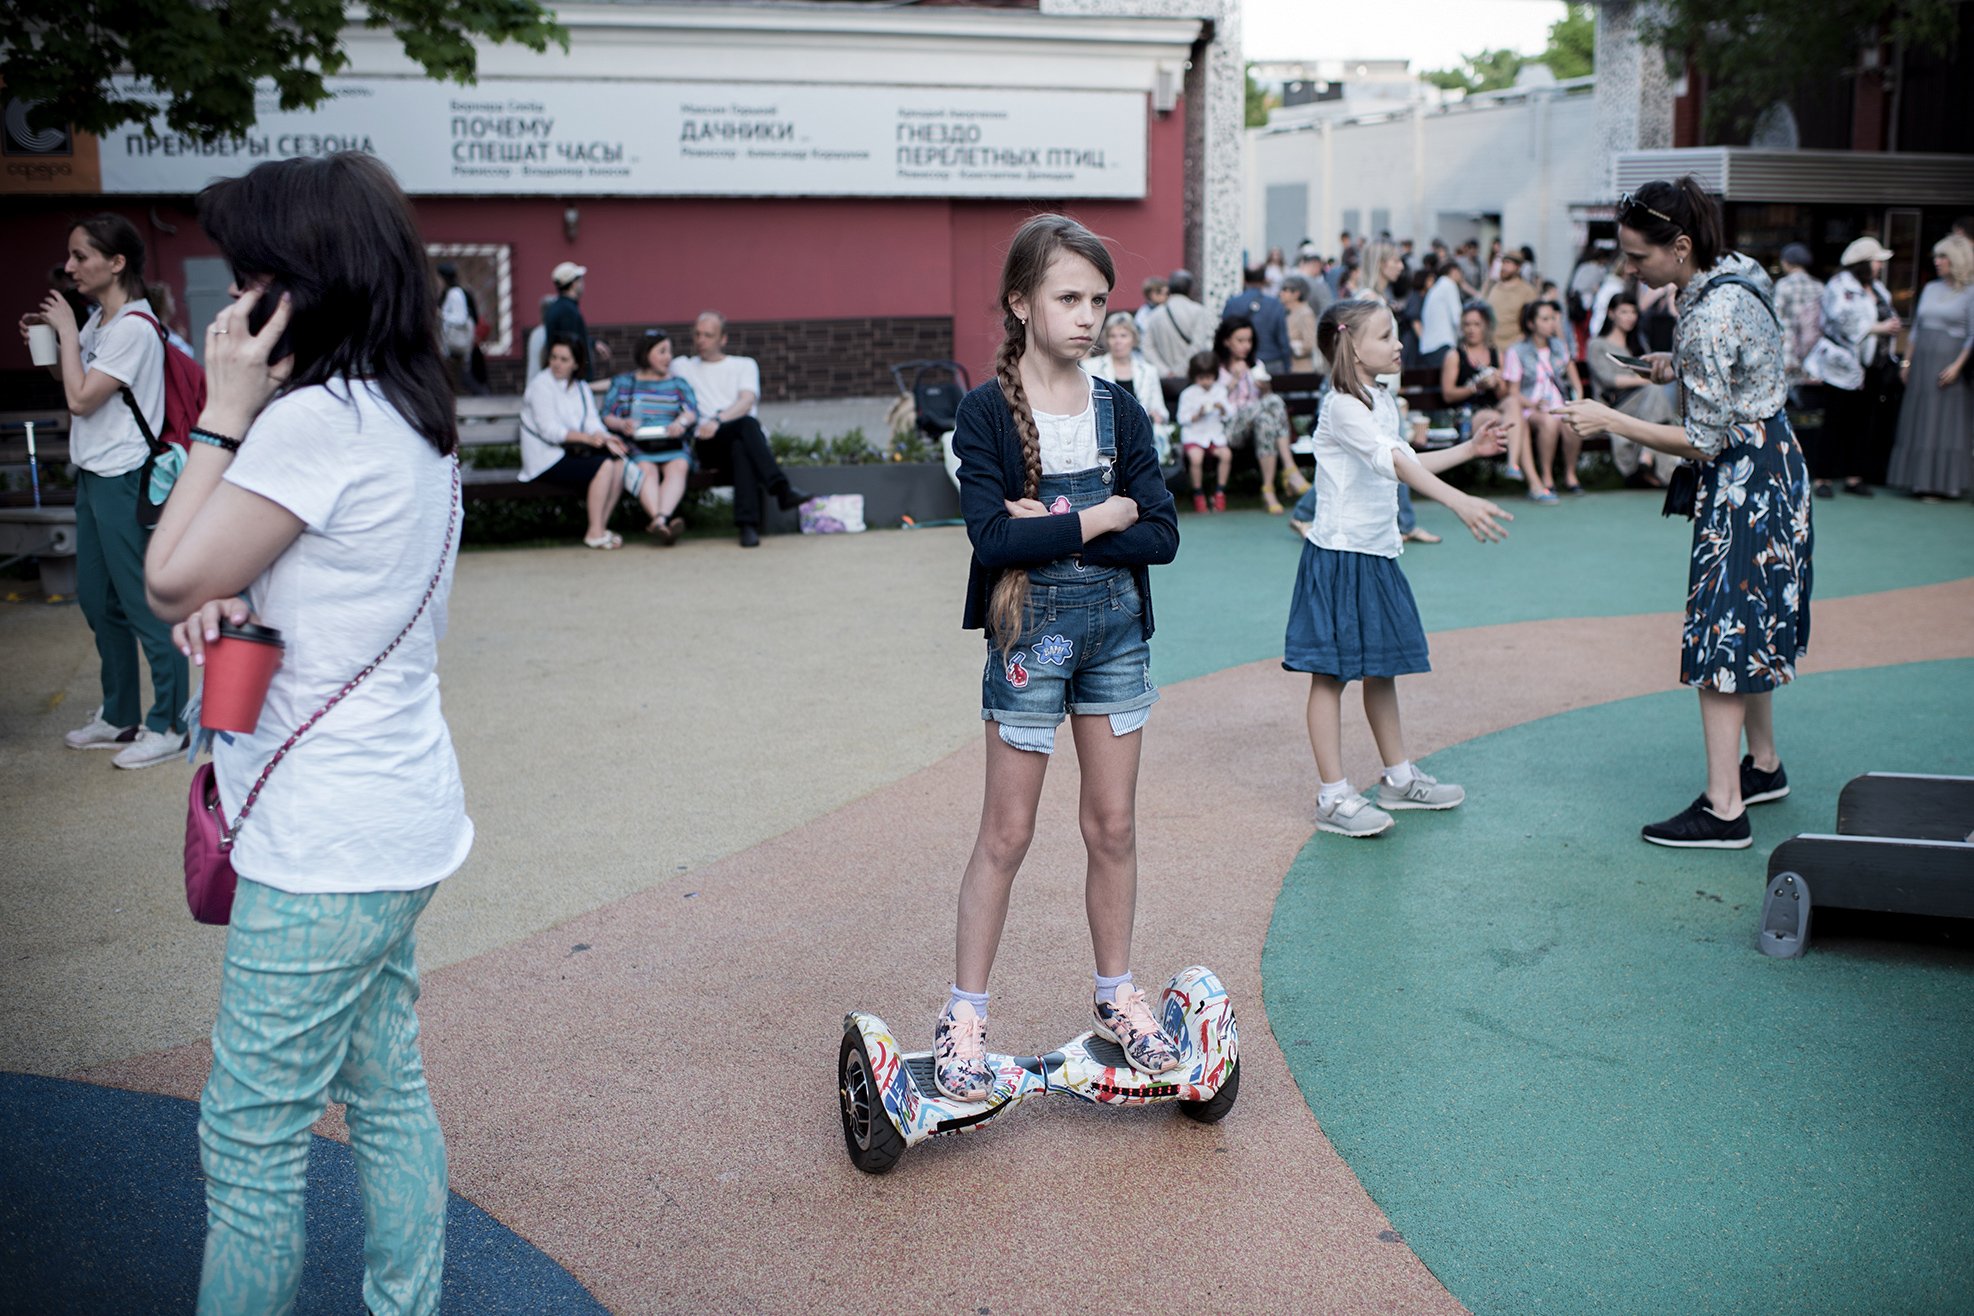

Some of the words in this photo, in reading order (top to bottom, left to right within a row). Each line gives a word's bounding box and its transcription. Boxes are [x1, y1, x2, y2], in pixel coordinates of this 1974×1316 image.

[450, 116, 554, 138] ПОЧЕМУ
[679, 120, 795, 143] ДАЧНИКИ
[896, 123, 982, 145] ГНЕЗДО
[126, 134, 270, 156] ПРЕМЬЕРЫ
[277, 134, 376, 156] СЕЗОНА
[451, 141, 550, 163] СПЕШАТ
[556, 142, 623, 163] ЧАСЫ
[896, 146, 1041, 167] ПЕРЕЛЕТНЫХ
[1046, 149, 1106, 169] ПТИЦ
